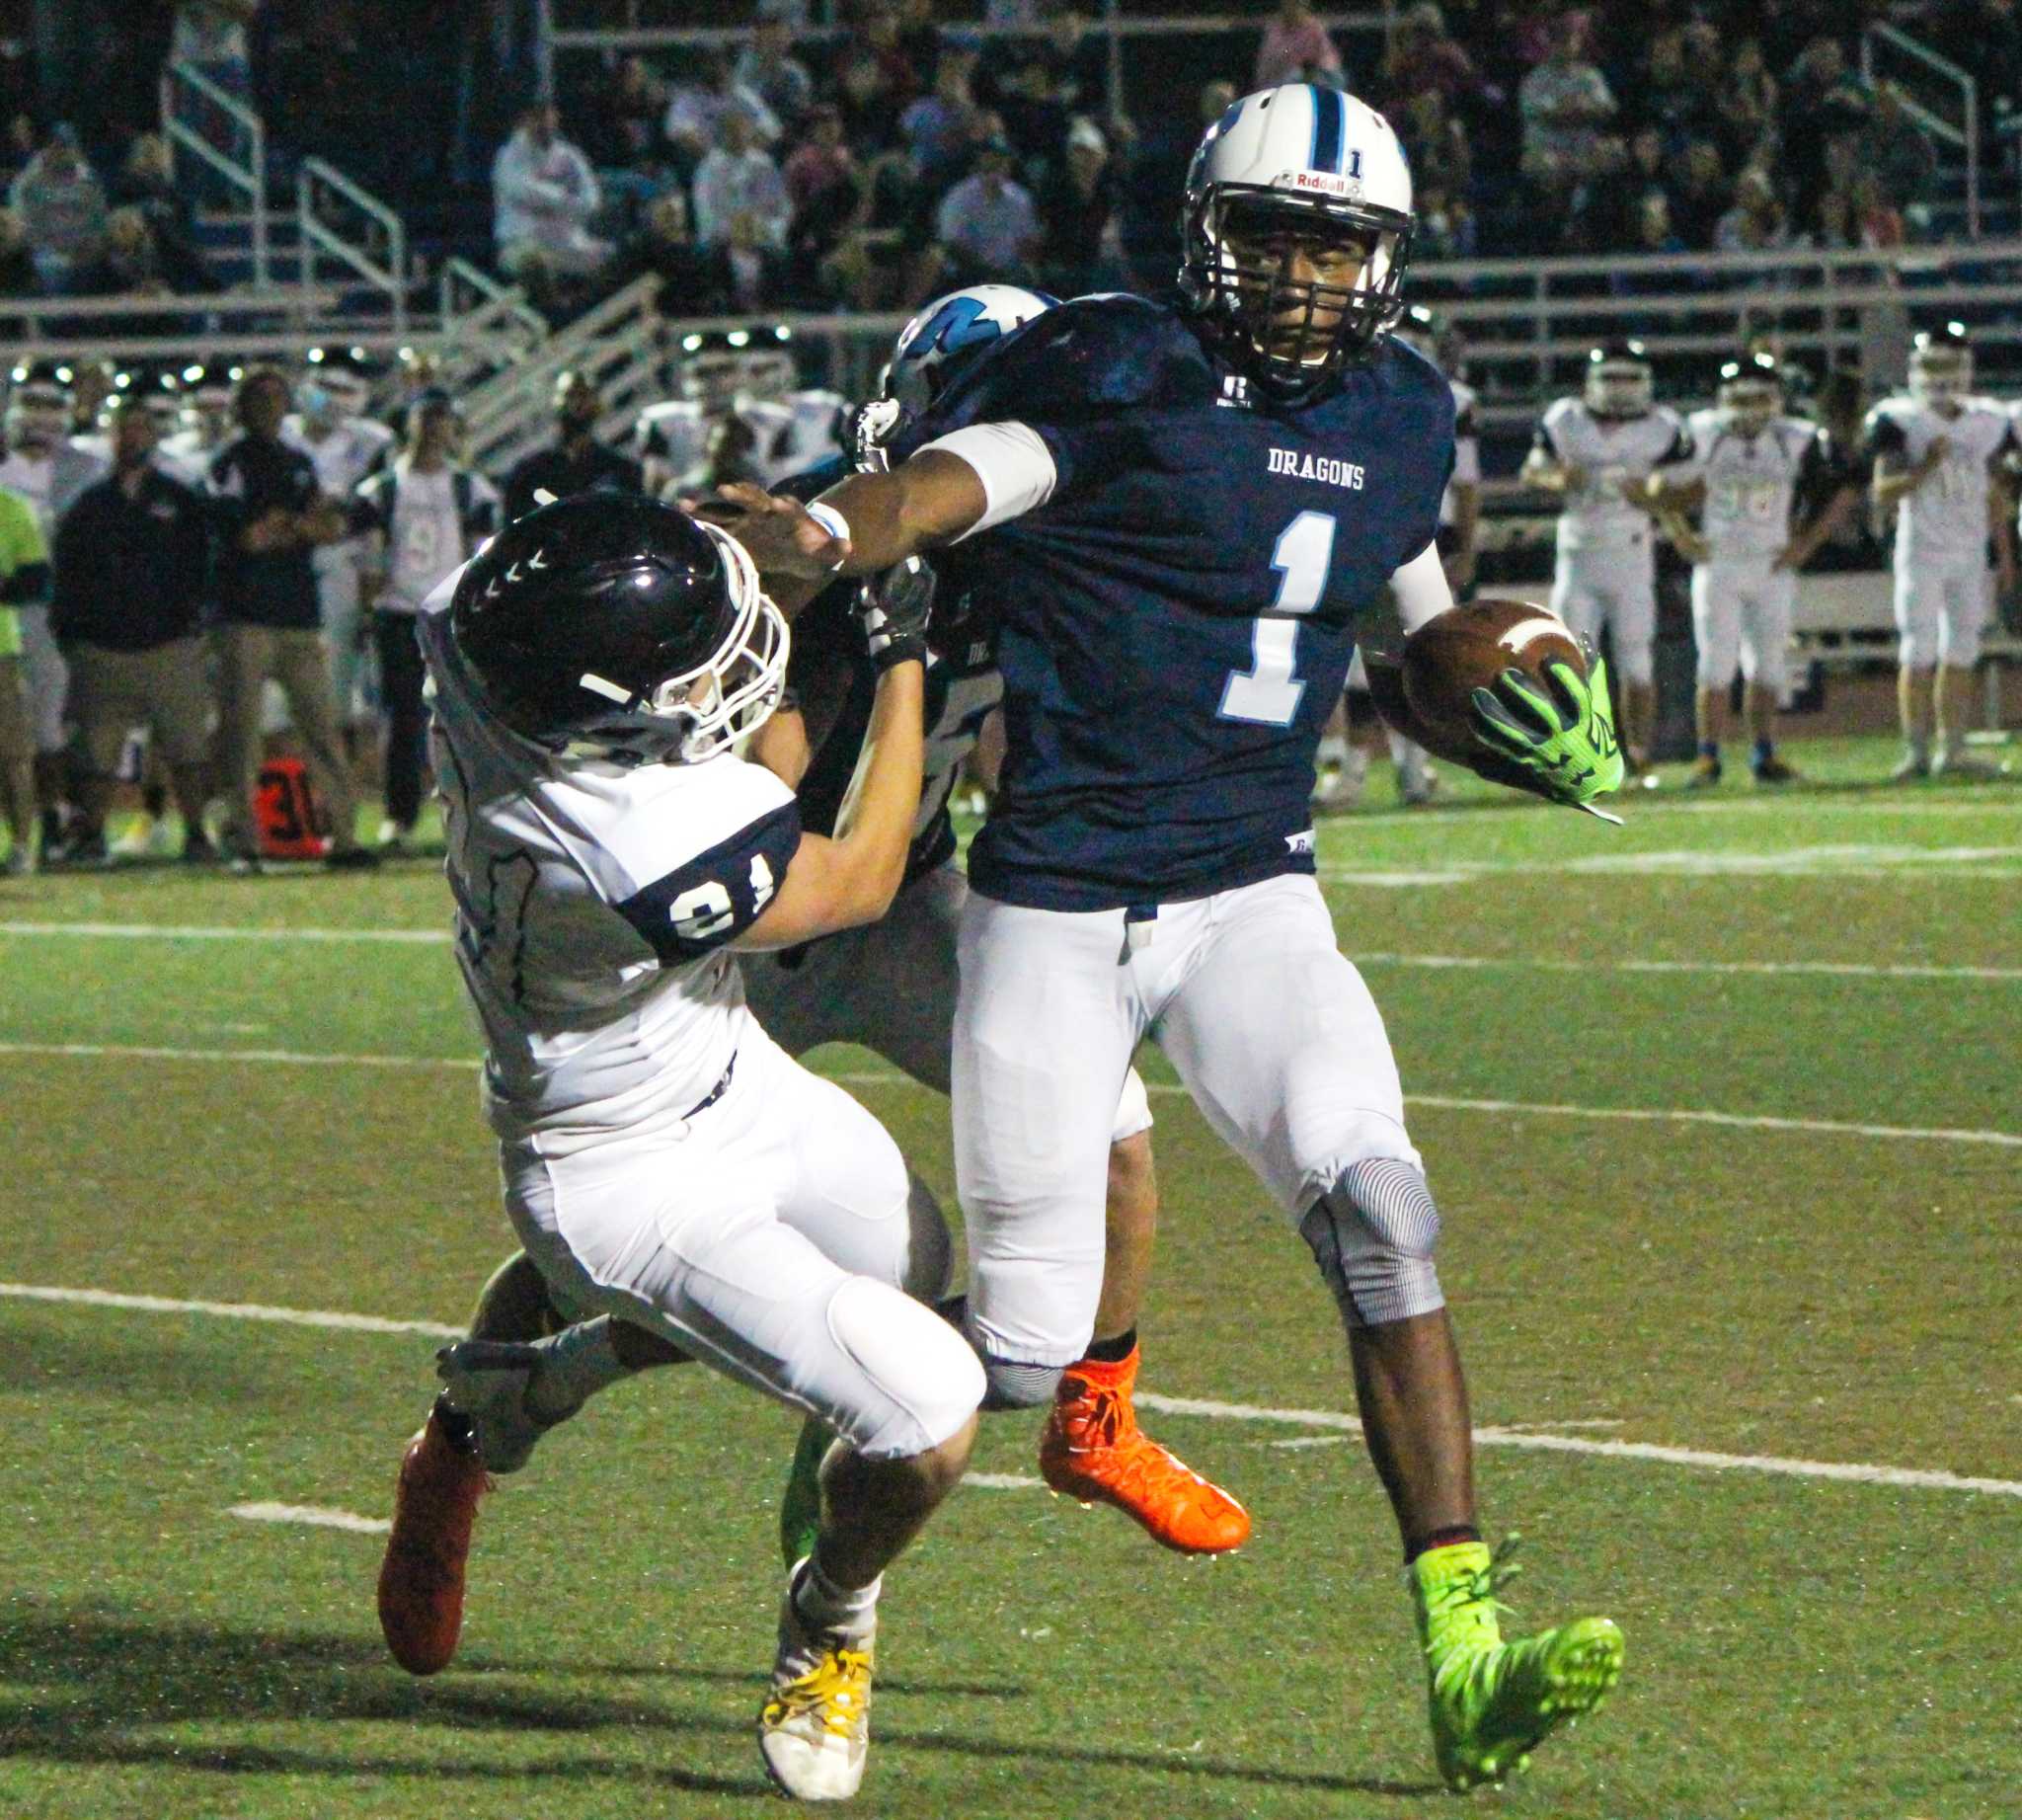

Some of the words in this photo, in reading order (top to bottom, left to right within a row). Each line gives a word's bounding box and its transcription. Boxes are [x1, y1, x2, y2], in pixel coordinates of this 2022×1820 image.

[1348, 149, 1362, 181] 1
[1268, 447, 1365, 491] DRAGONS
[1215, 510, 1337, 729] 1
